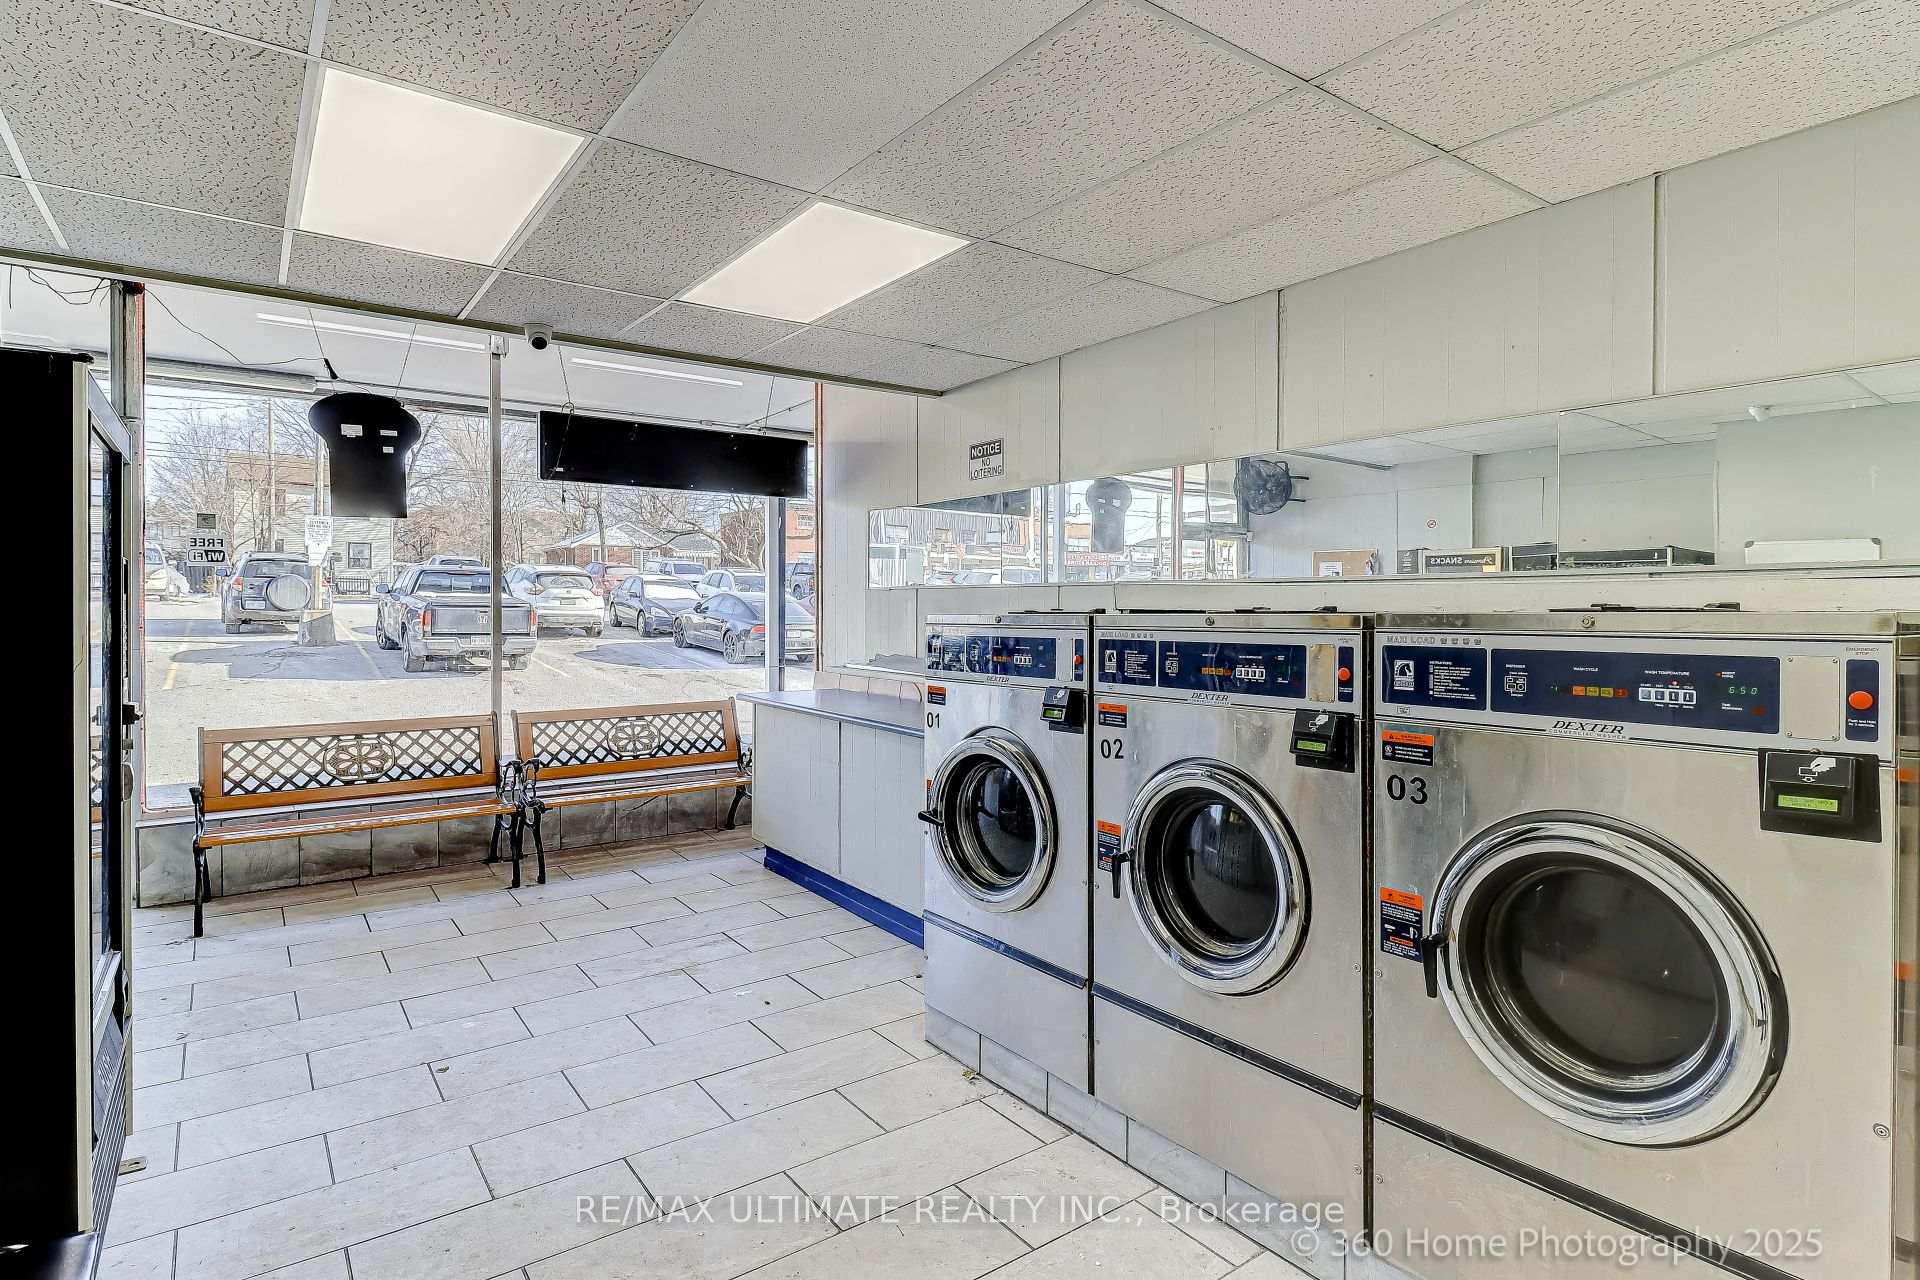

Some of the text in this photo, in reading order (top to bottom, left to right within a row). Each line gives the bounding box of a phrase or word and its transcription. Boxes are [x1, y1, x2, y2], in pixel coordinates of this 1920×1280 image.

[971, 442, 1001, 457] NOTICE
[981, 457, 991, 467] NO
[970, 464, 1002, 480] LOITERING
[986, 675, 1009, 683] DEXTER
[1190, 692, 1230, 702] DEXTER
[926, 711, 940, 729] 01
[1551, 720, 1625, 735] DEXTER
[1100, 738, 1125, 760] 02
[1386, 774, 1428, 805] 03
